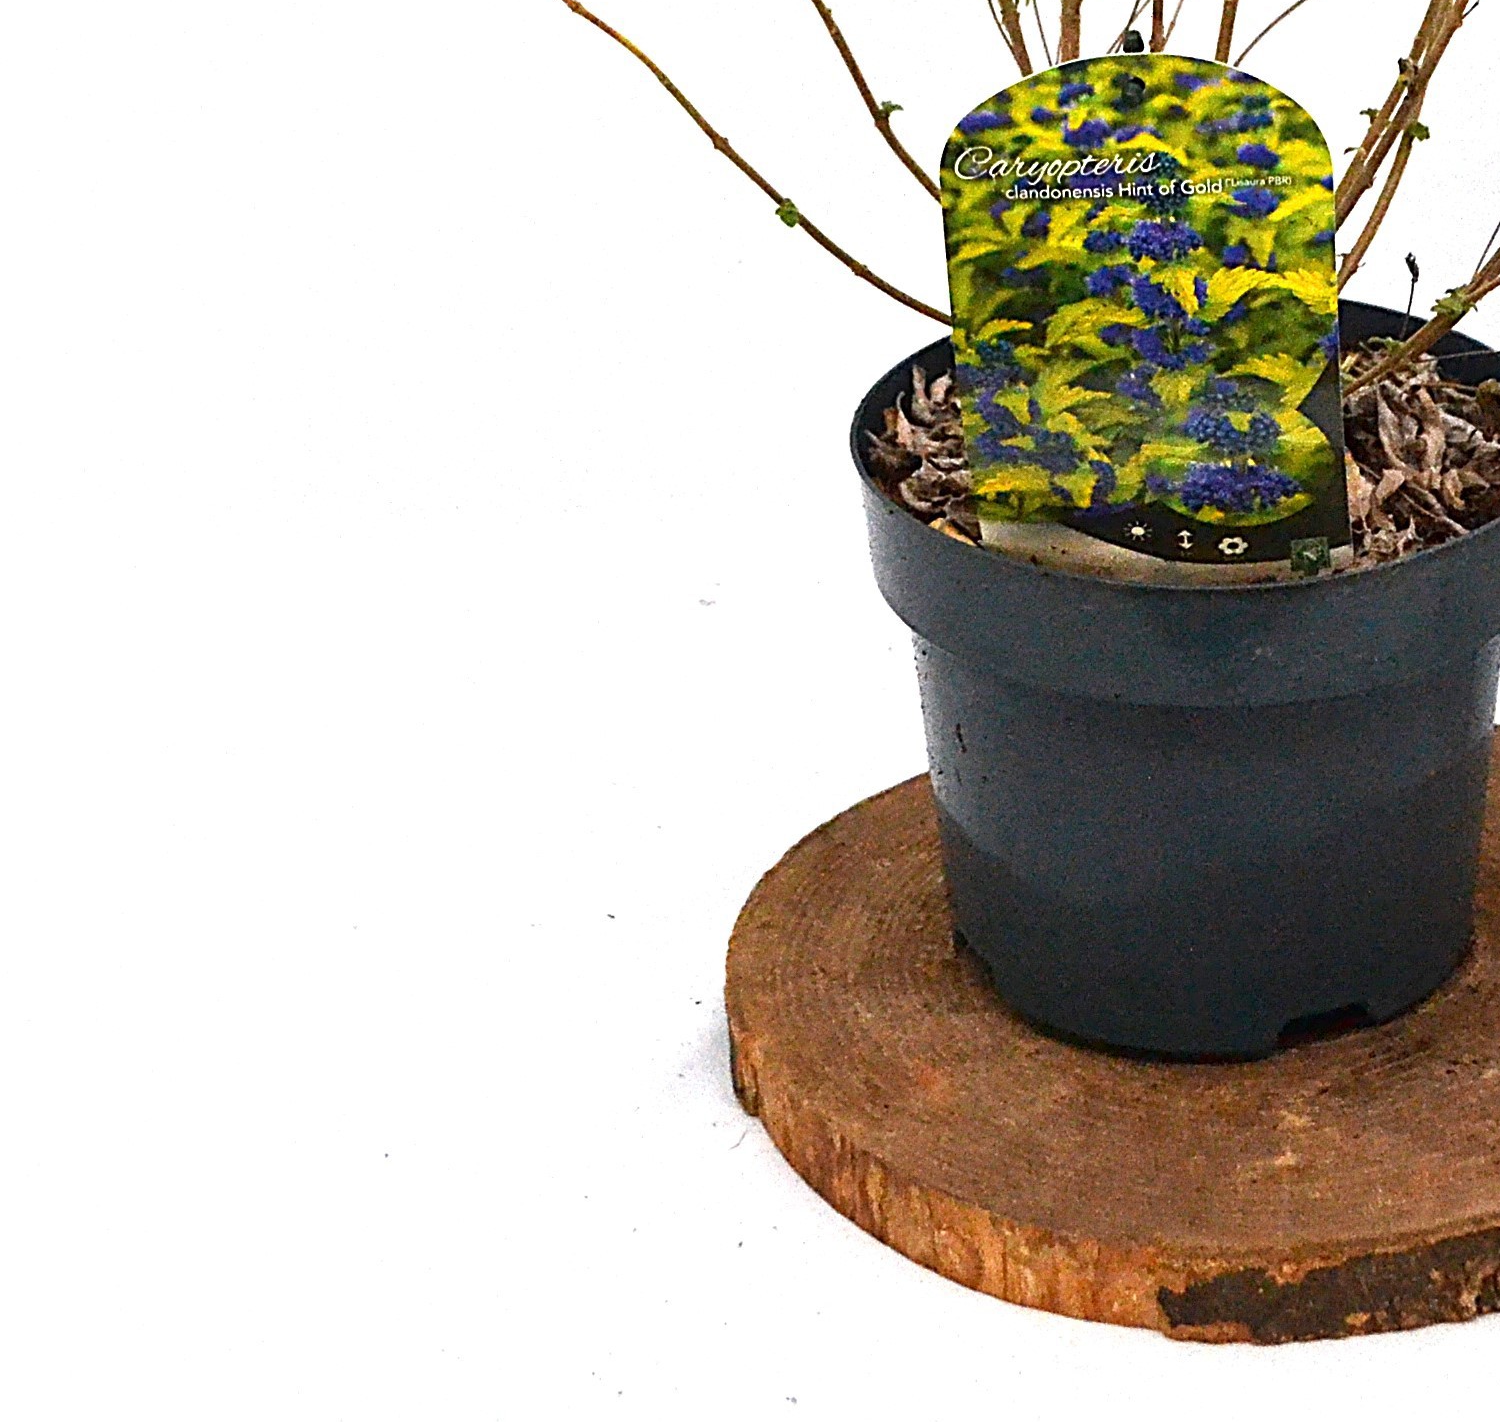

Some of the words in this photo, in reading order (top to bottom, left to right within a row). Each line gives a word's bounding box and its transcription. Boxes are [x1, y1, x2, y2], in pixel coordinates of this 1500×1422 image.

[954, 146, 1160, 186] Caryopteris
[1005, 184, 1113, 200] clandonensis
[1118, 181, 1153, 197] Hint
[1159, 179, 1175, 195] of
[1180, 178, 1223, 194] Gold
